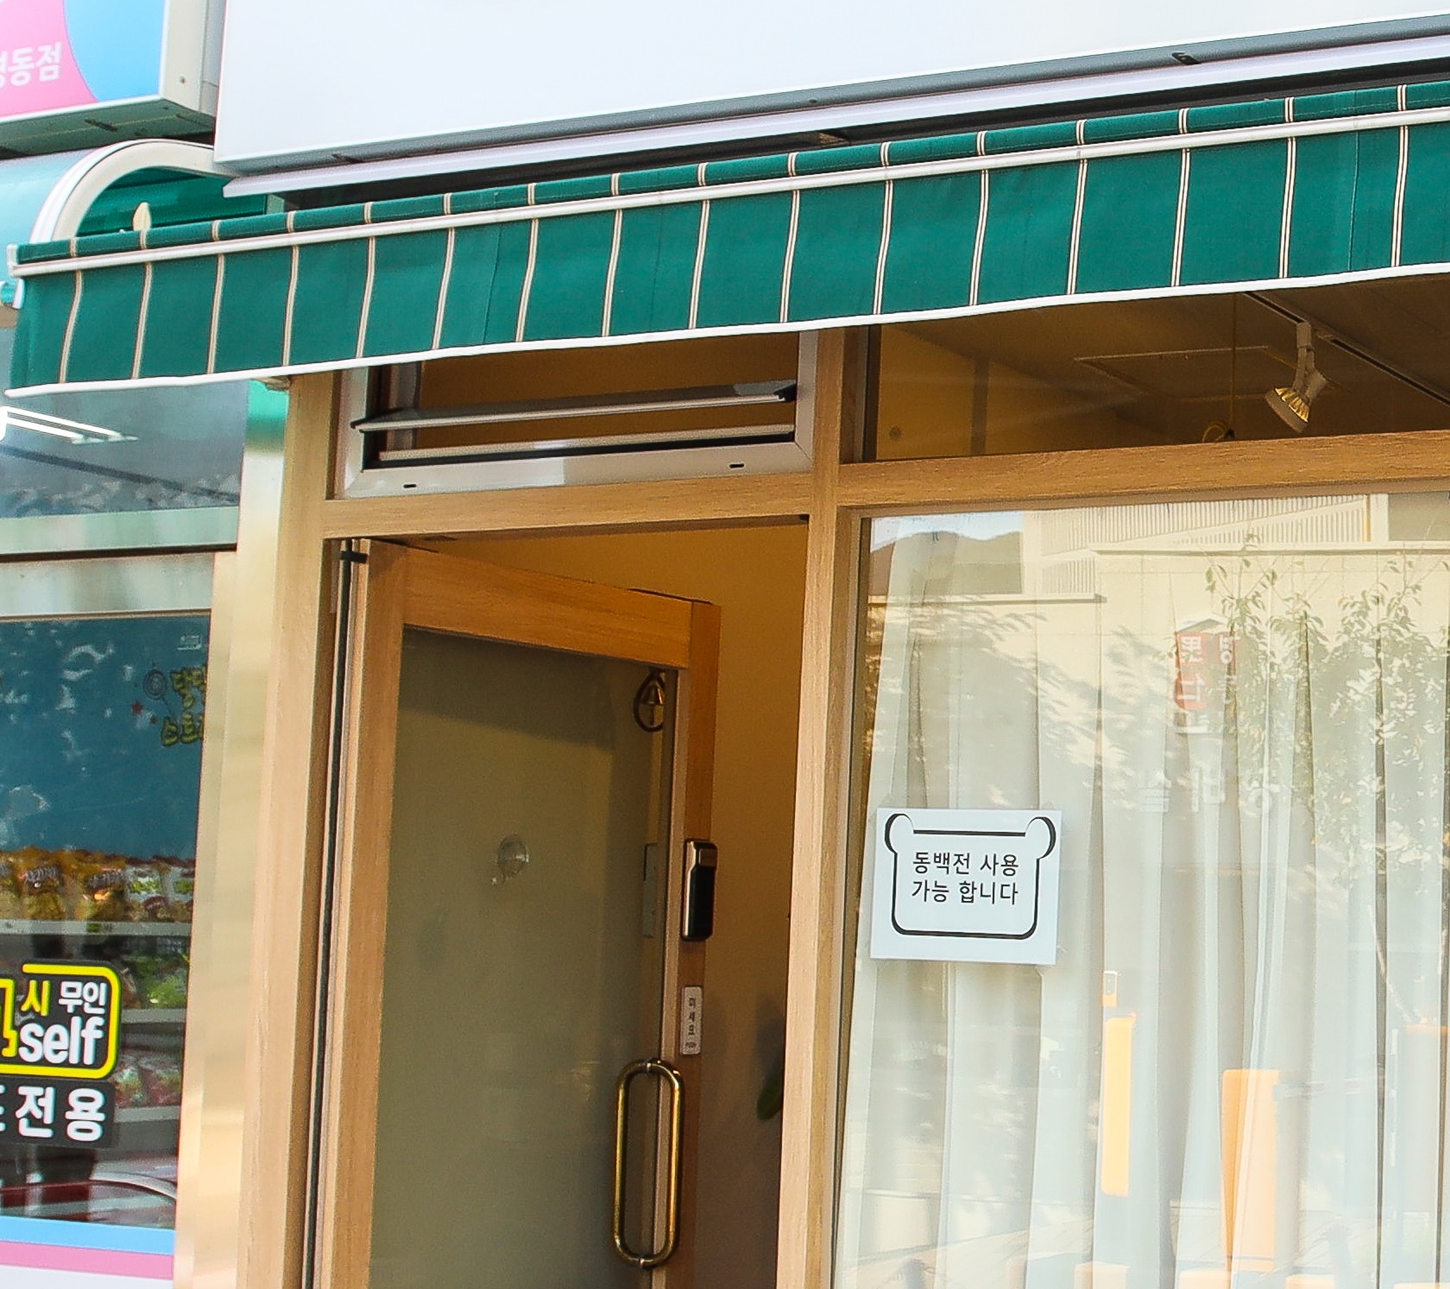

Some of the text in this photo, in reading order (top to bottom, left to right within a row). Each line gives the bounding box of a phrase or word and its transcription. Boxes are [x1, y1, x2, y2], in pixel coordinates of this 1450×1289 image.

[912, 851, 1019, 877] 동백전 사용
[911, 879, 1019, 905] 가능 합니다
[58, 981, 107, 1015] 무인
[18, 1016, 105, 1066] self
